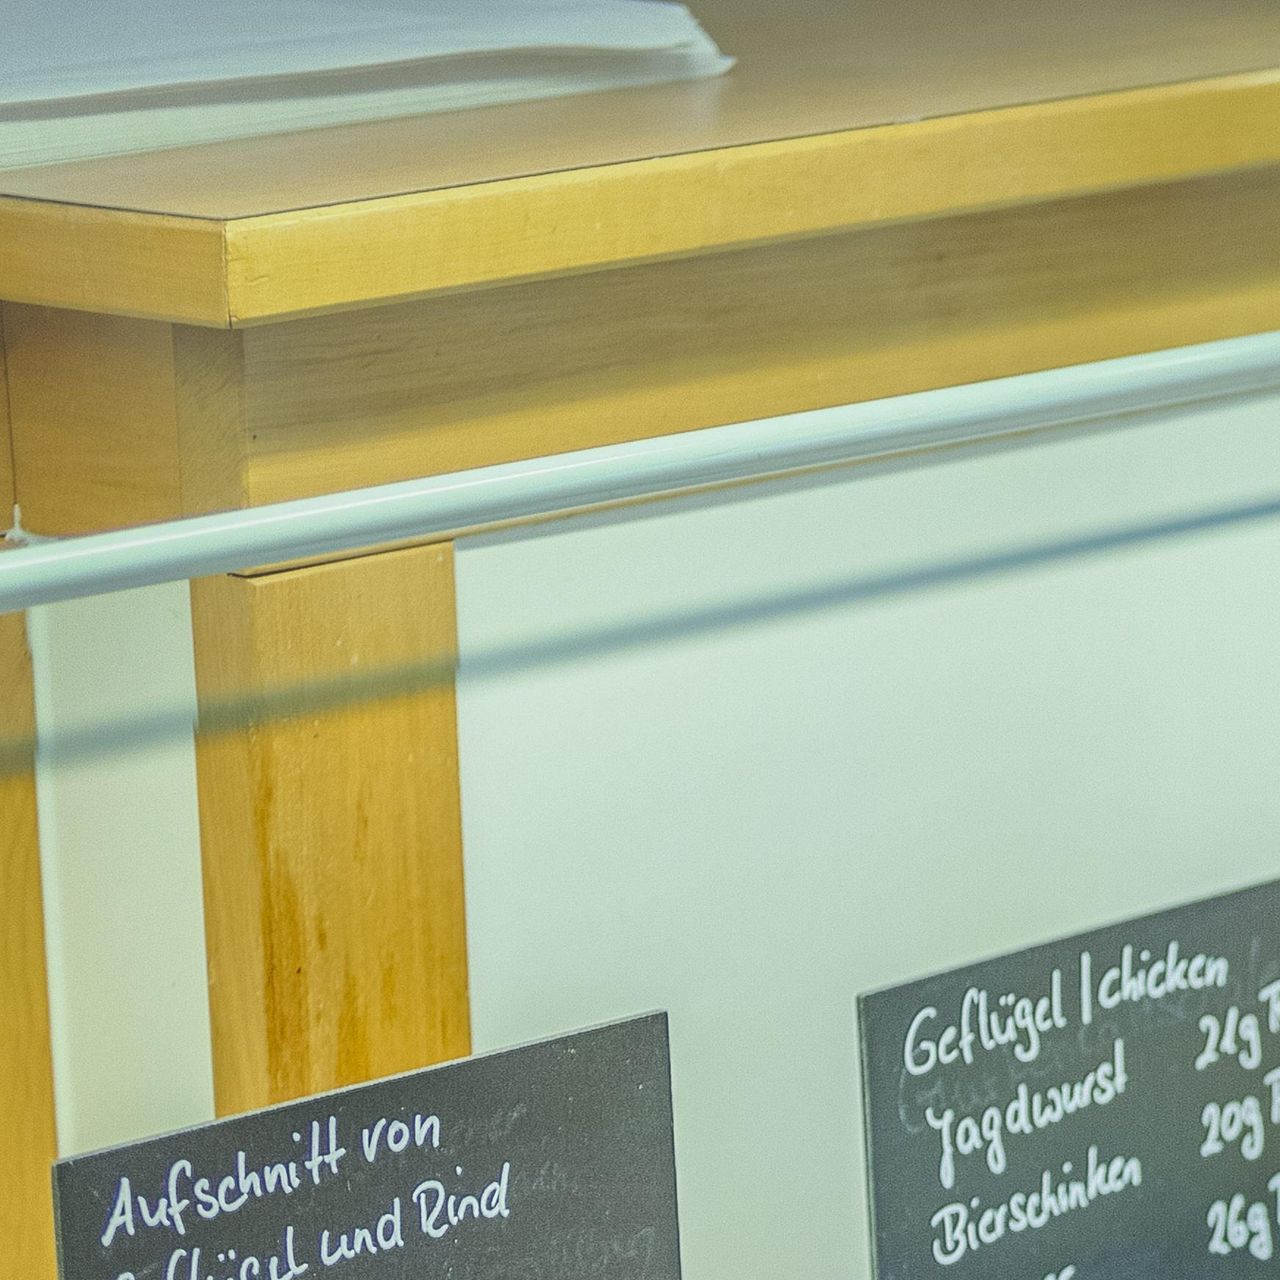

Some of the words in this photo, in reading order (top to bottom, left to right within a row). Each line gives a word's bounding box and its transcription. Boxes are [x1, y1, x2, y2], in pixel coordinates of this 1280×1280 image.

[904, 969, 1066, 1075] Geflügel
[1099, 941, 1229, 1009] chicken
[1196, 1005, 1262, 1070] 21g
[102, 1115, 345, 1246] Aufschnitt
[362, 1112, 441, 1161] von
[321, 1197, 405, 1262] und
[412, 1161, 510, 1238] Rind
[930, 1145, 1143, 1266] Bierschinken
[1201, 1095, 1264, 1161] 20g
[1206, 1194, 1273, 1261] 26g
